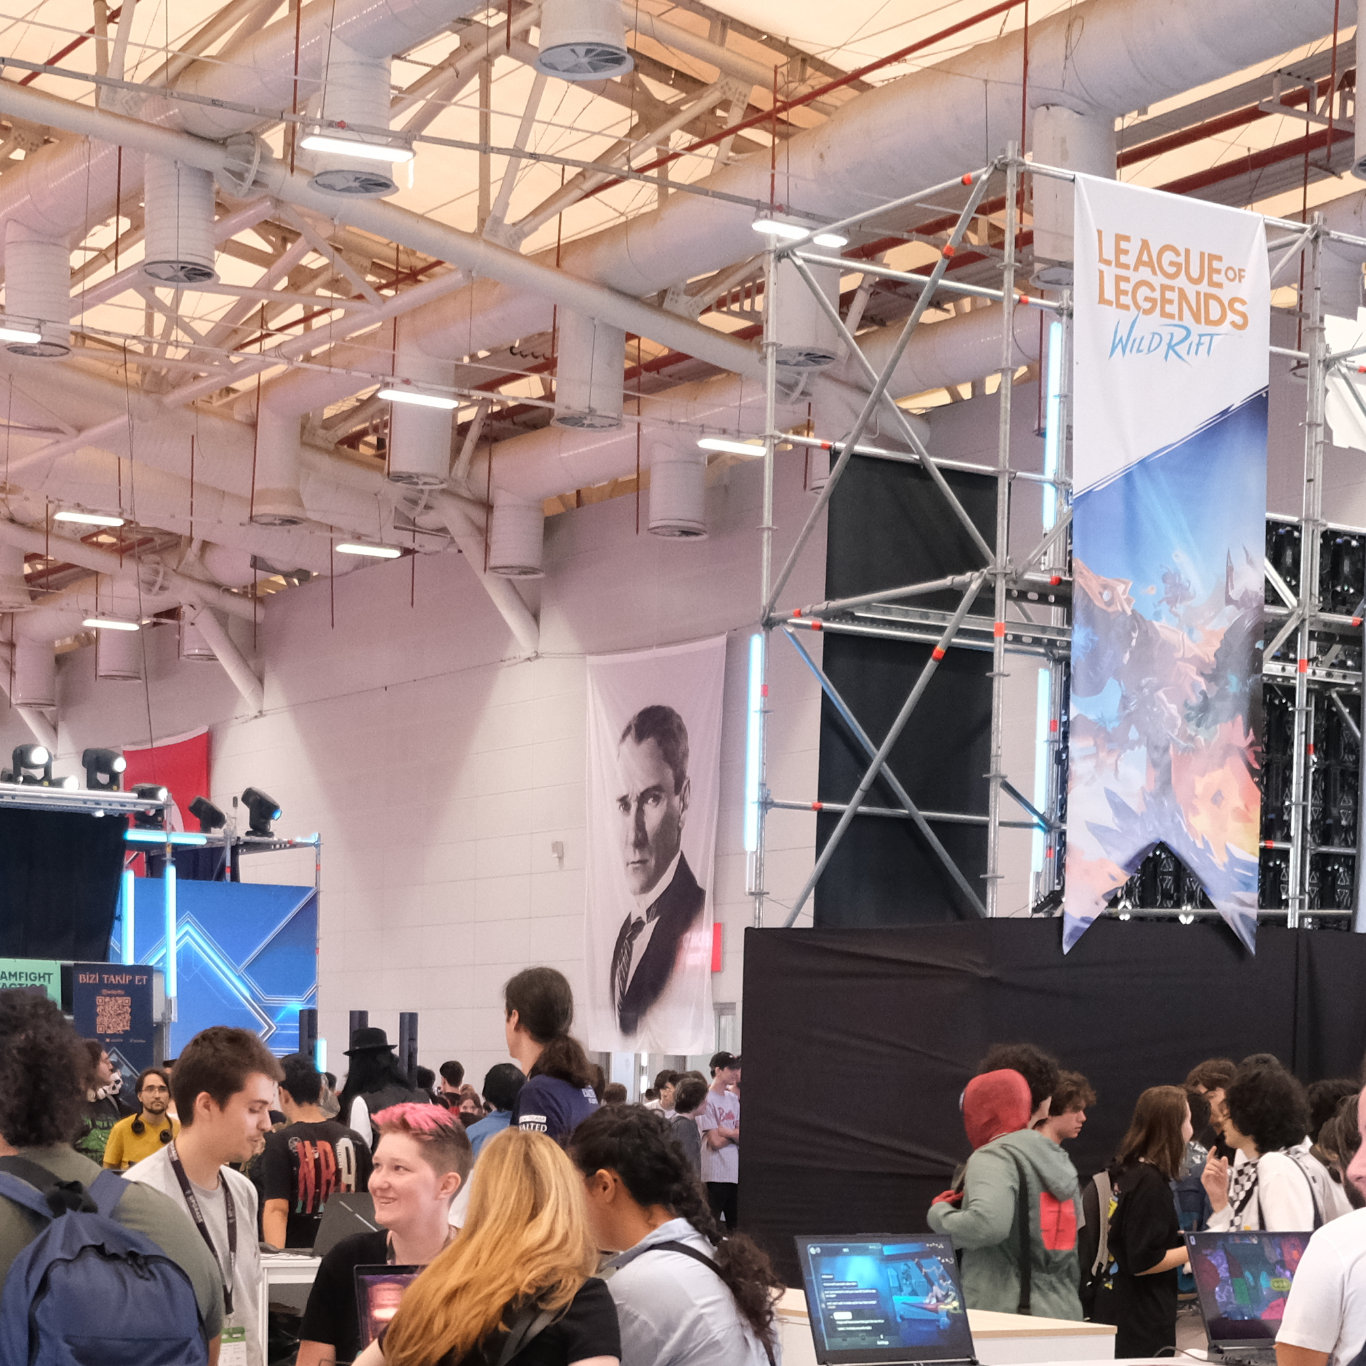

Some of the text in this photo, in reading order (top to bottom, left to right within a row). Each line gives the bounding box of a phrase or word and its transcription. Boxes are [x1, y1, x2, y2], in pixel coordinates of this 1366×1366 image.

[1096, 229, 1246, 289] LEAGUE OF
[1097, 268, 1249, 331] LEGENDS
[79, 972, 148, 985] BİZİ TAKİP ET
